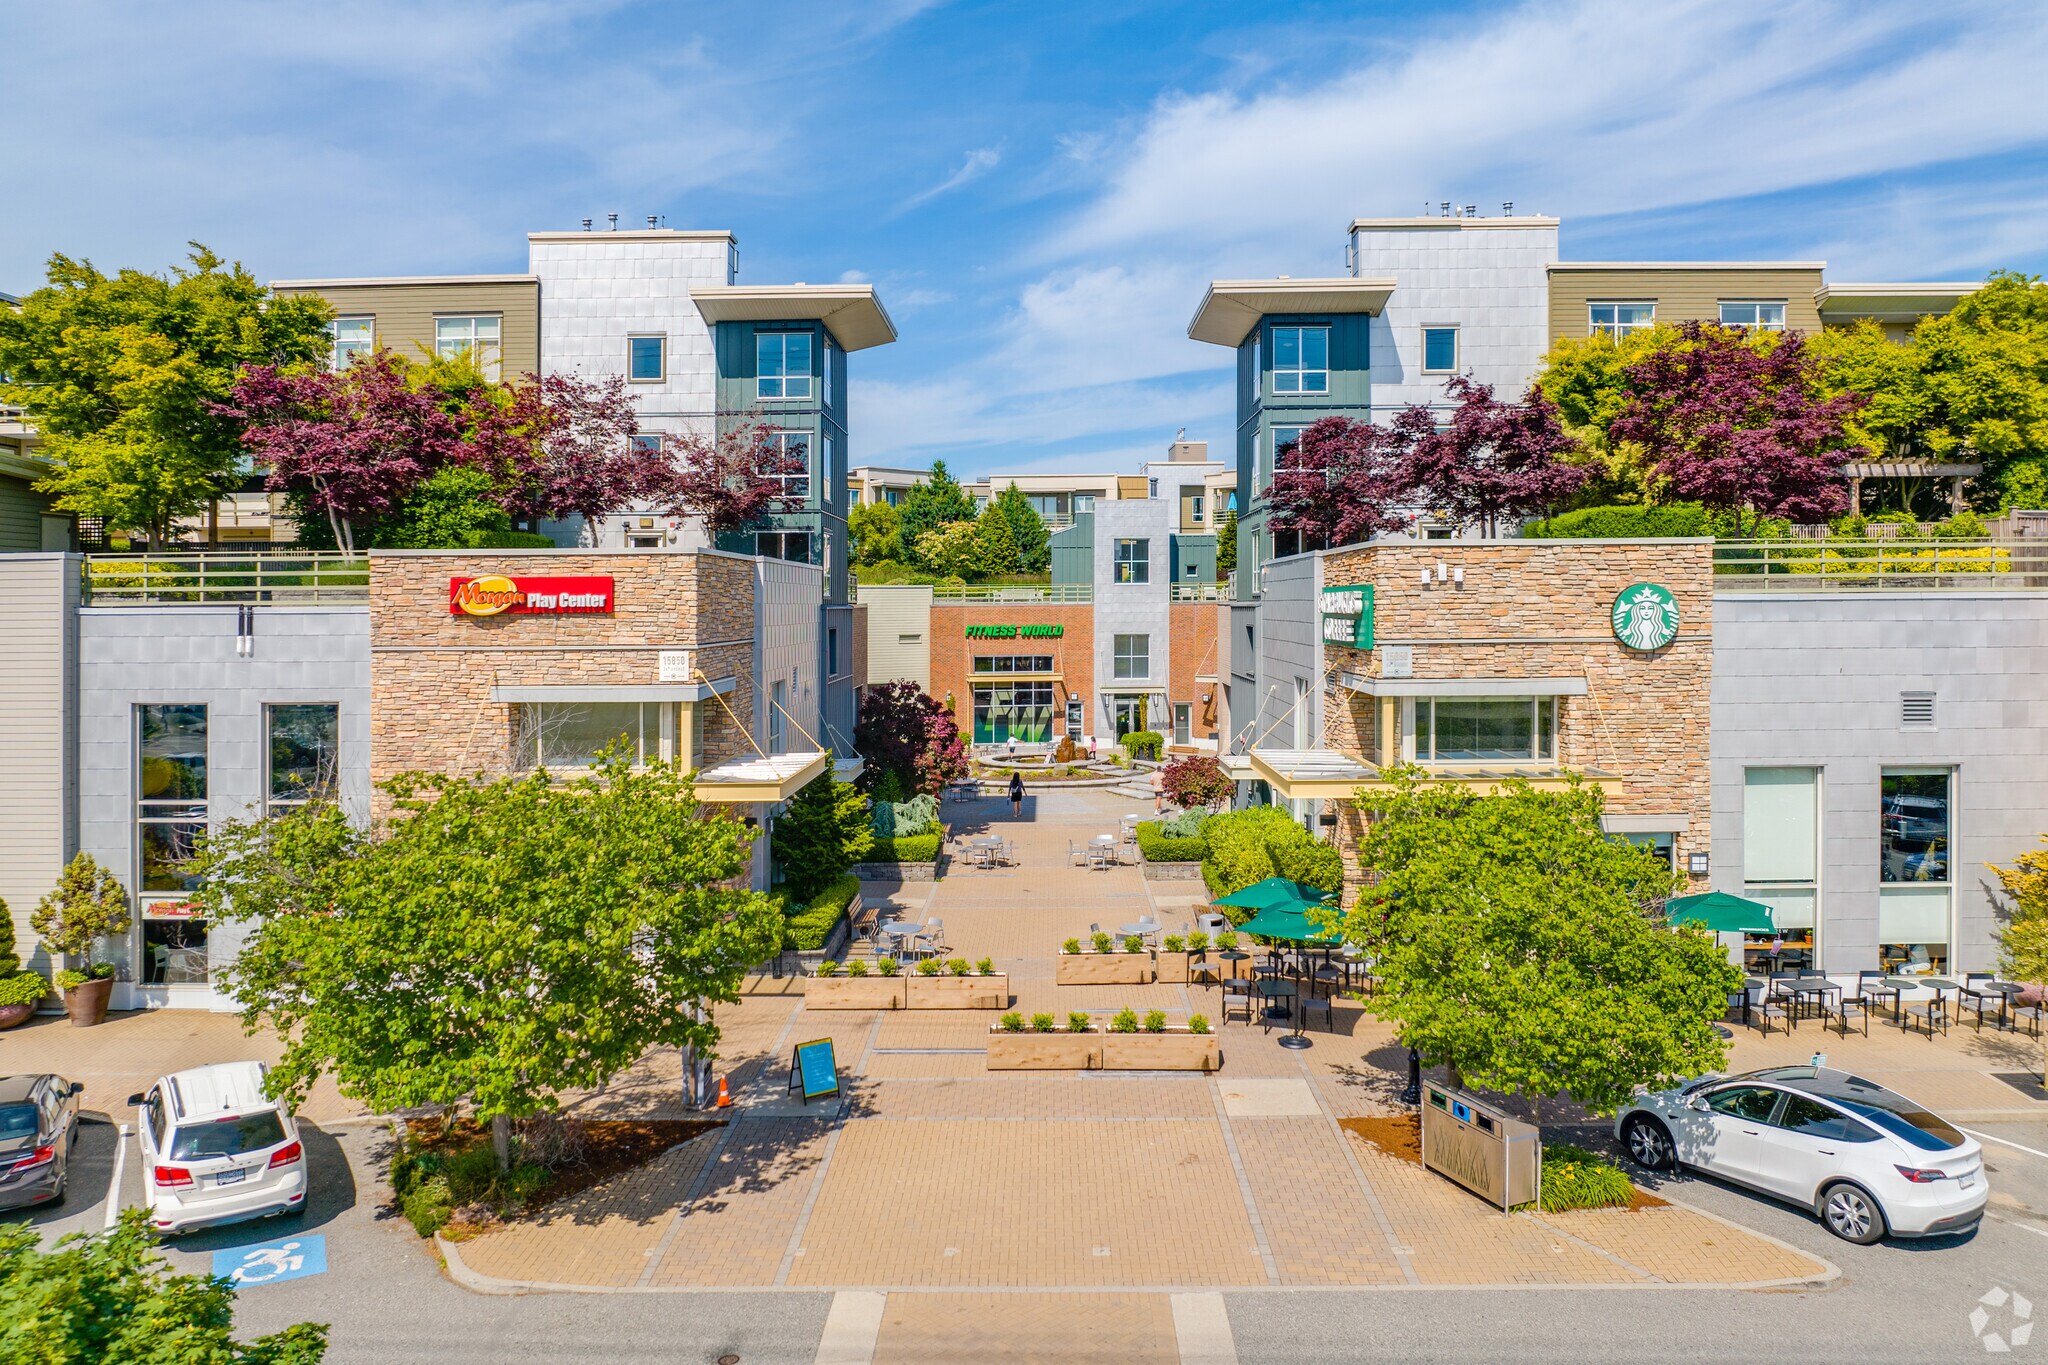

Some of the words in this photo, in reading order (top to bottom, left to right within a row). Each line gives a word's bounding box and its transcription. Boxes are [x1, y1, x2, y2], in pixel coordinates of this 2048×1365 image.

[452, 582, 526, 608] Morgan
[527, 592, 558, 609] Play
[559, 592, 606, 608] Center
[965, 624, 1017, 637] FITNESS
[1021, 624, 1063, 637] WORLD
[663, 656, 685, 666] 15850
